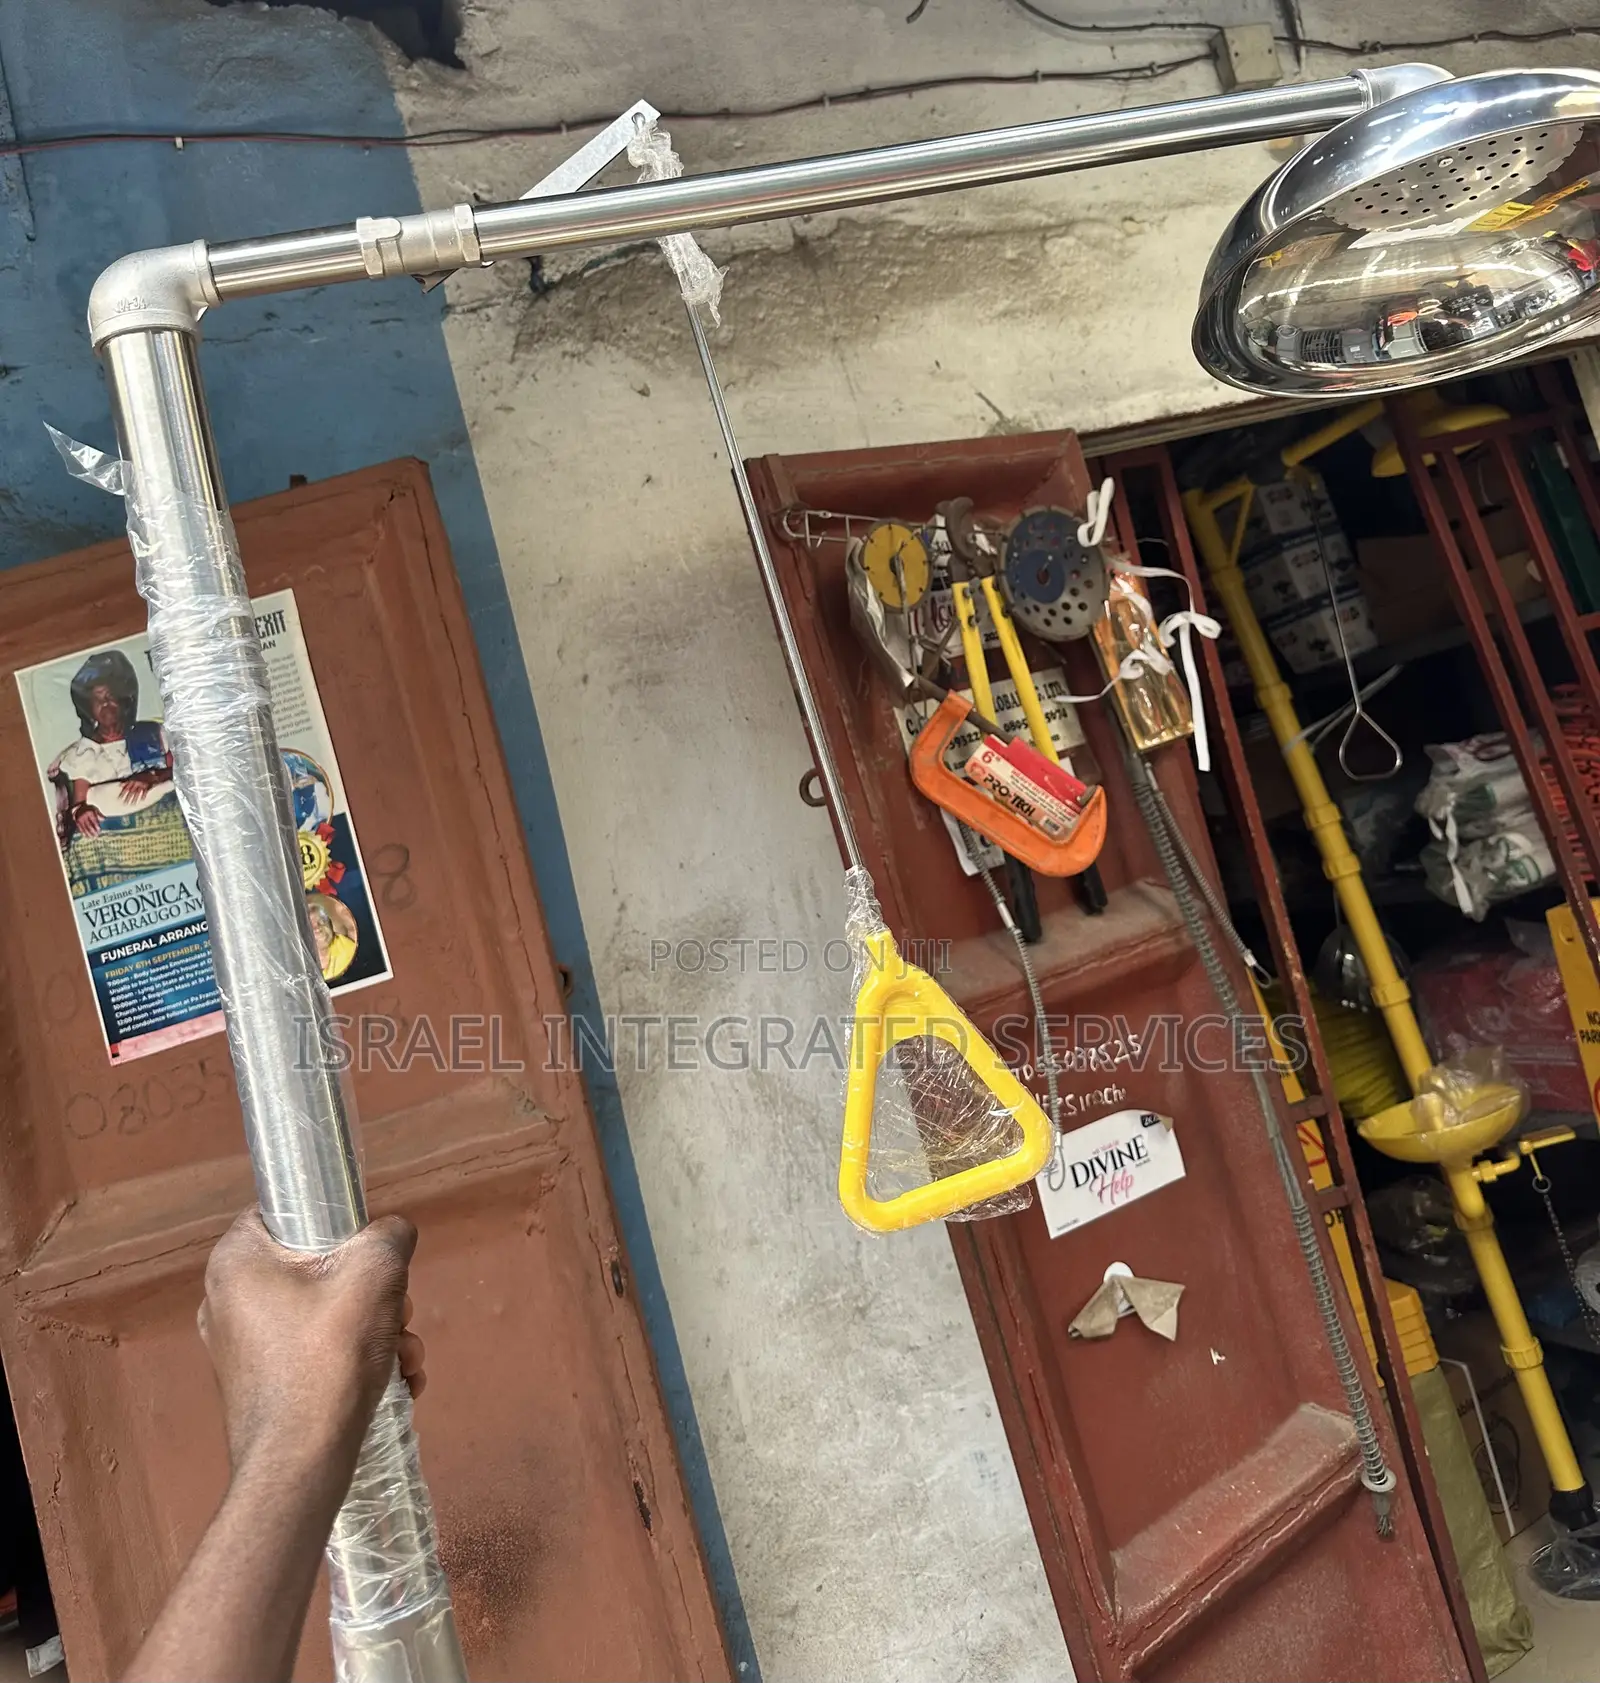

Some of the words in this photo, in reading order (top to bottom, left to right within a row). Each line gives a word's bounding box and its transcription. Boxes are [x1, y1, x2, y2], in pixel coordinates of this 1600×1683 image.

[254, 609, 286, 639] EXIT
[81, 899, 101, 910] Late
[136, 882, 154, 894] Mrs
[84, 882, 193, 928] VERONICA
[90, 904, 181, 944] ACHARAUGO
[101, 936, 157, 964] FUNERAL
[105, 965, 133, 979] FRIDAY
[135, 958, 150, 969] 6TH
[134, 970, 148, 980] Body
[150, 963, 167, 974] leaves
[139, 978, 148, 986] her
[150, 969, 179, 982] husband's
[180, 962, 197, 972] house
[138, 984, 154, 995] Lying
[162, 976, 176, 986] State
[148, 987, 173, 1000] Requiem
[175, 981, 189, 990] Mass
[116, 1006, 136, 1017] Church
[119, 1025, 130, 1033] and
[131, 1014, 165, 1029] condolence
[166, 1006, 186, 1018] follows
[133, 1011, 147, 1020] noon
[153, 1001, 181, 1014] Interment
[1069, 1134, 1149, 1188] DIVINE
[1089, 1169, 1135, 1206] Help
